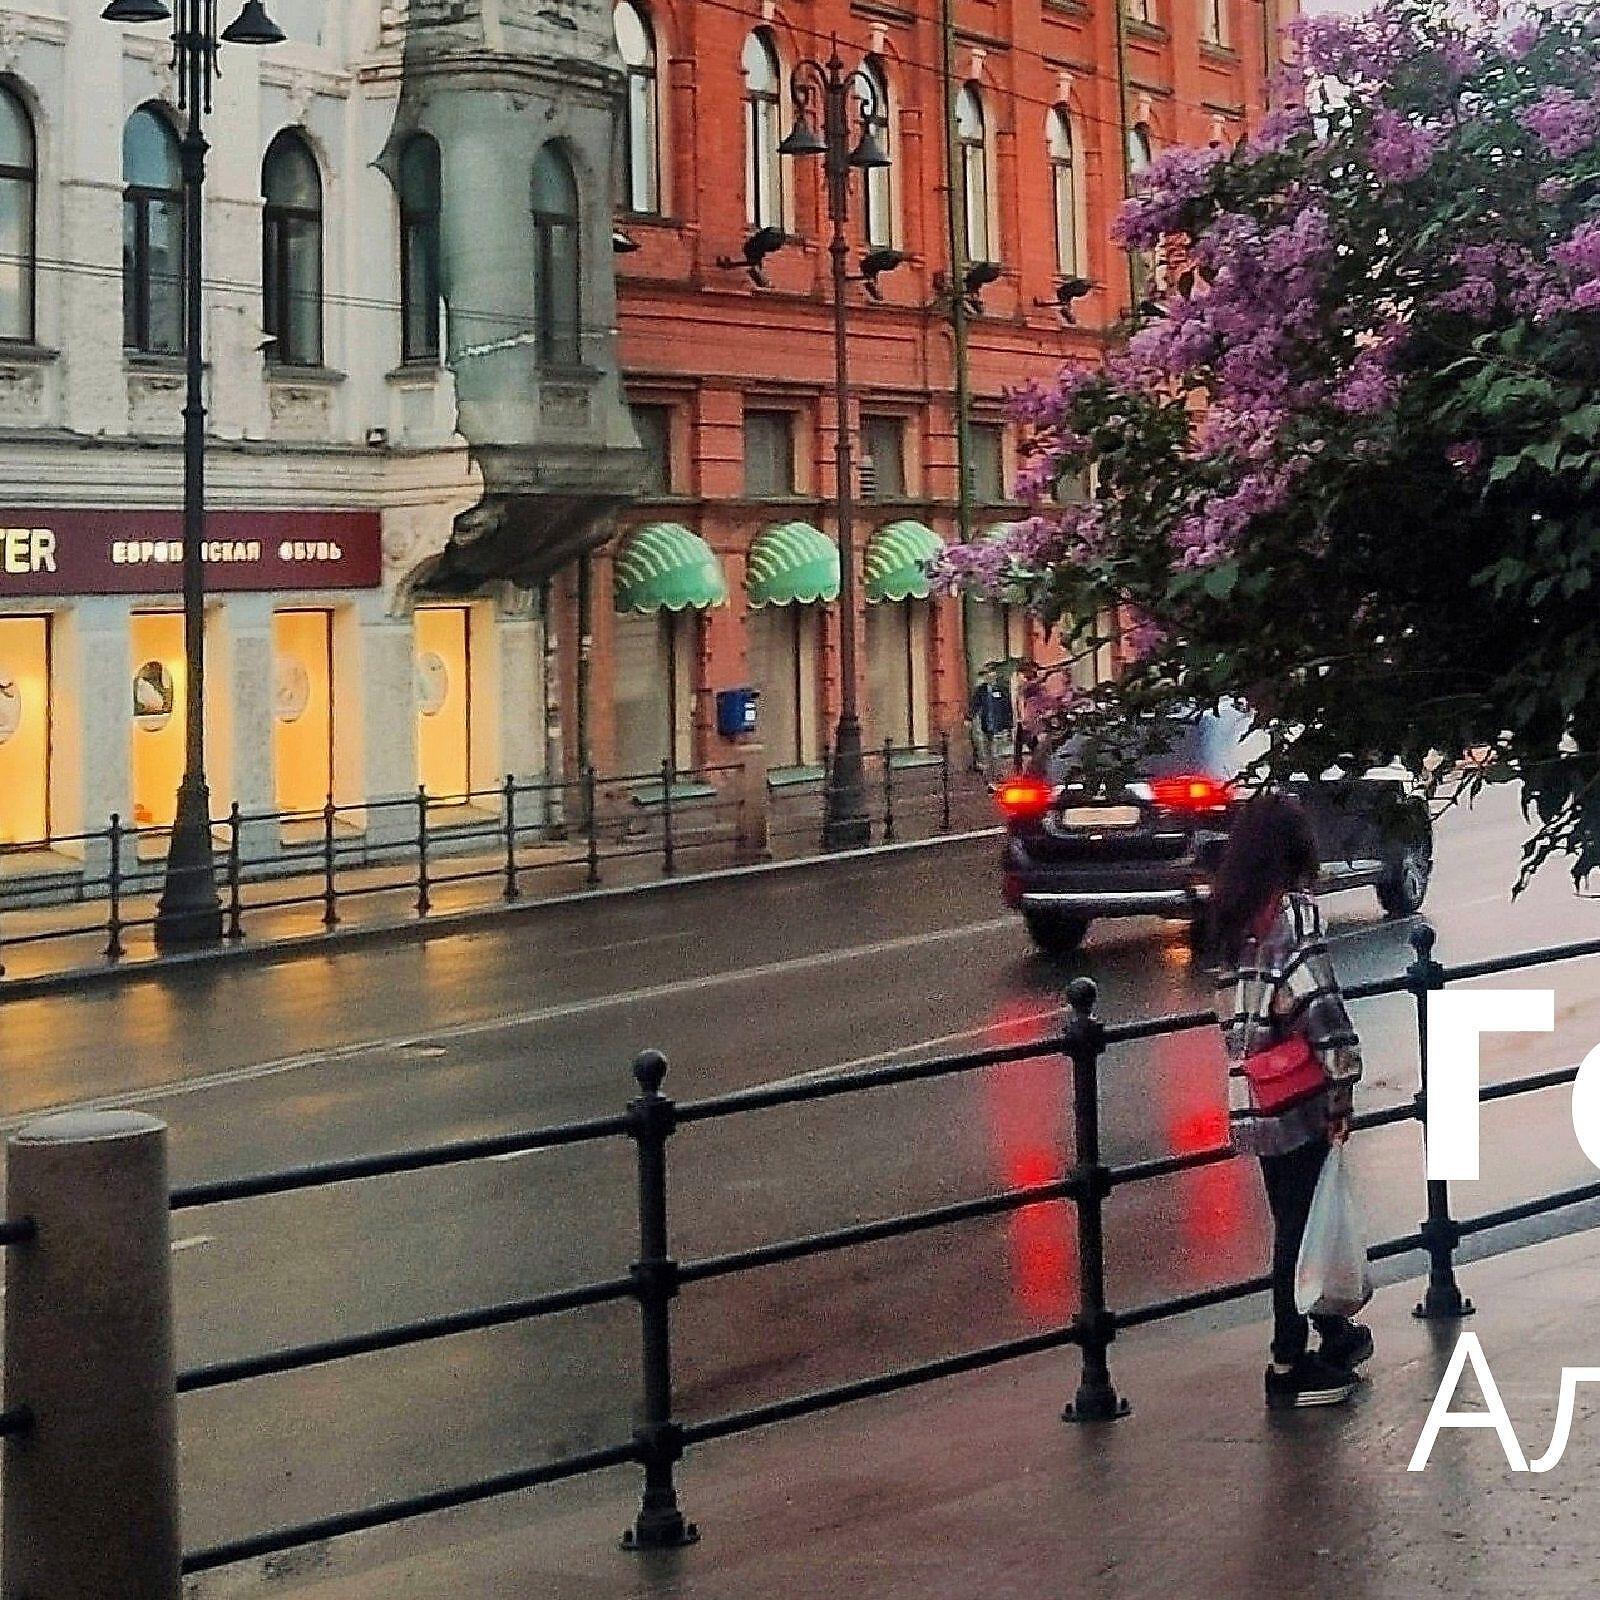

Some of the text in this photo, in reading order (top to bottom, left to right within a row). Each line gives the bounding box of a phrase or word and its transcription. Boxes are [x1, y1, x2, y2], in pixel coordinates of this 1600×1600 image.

[0, 528, 56, 573] ER
[112, 540, 341, 562] ЕВРОПСКАЯ ОБУВЬ
